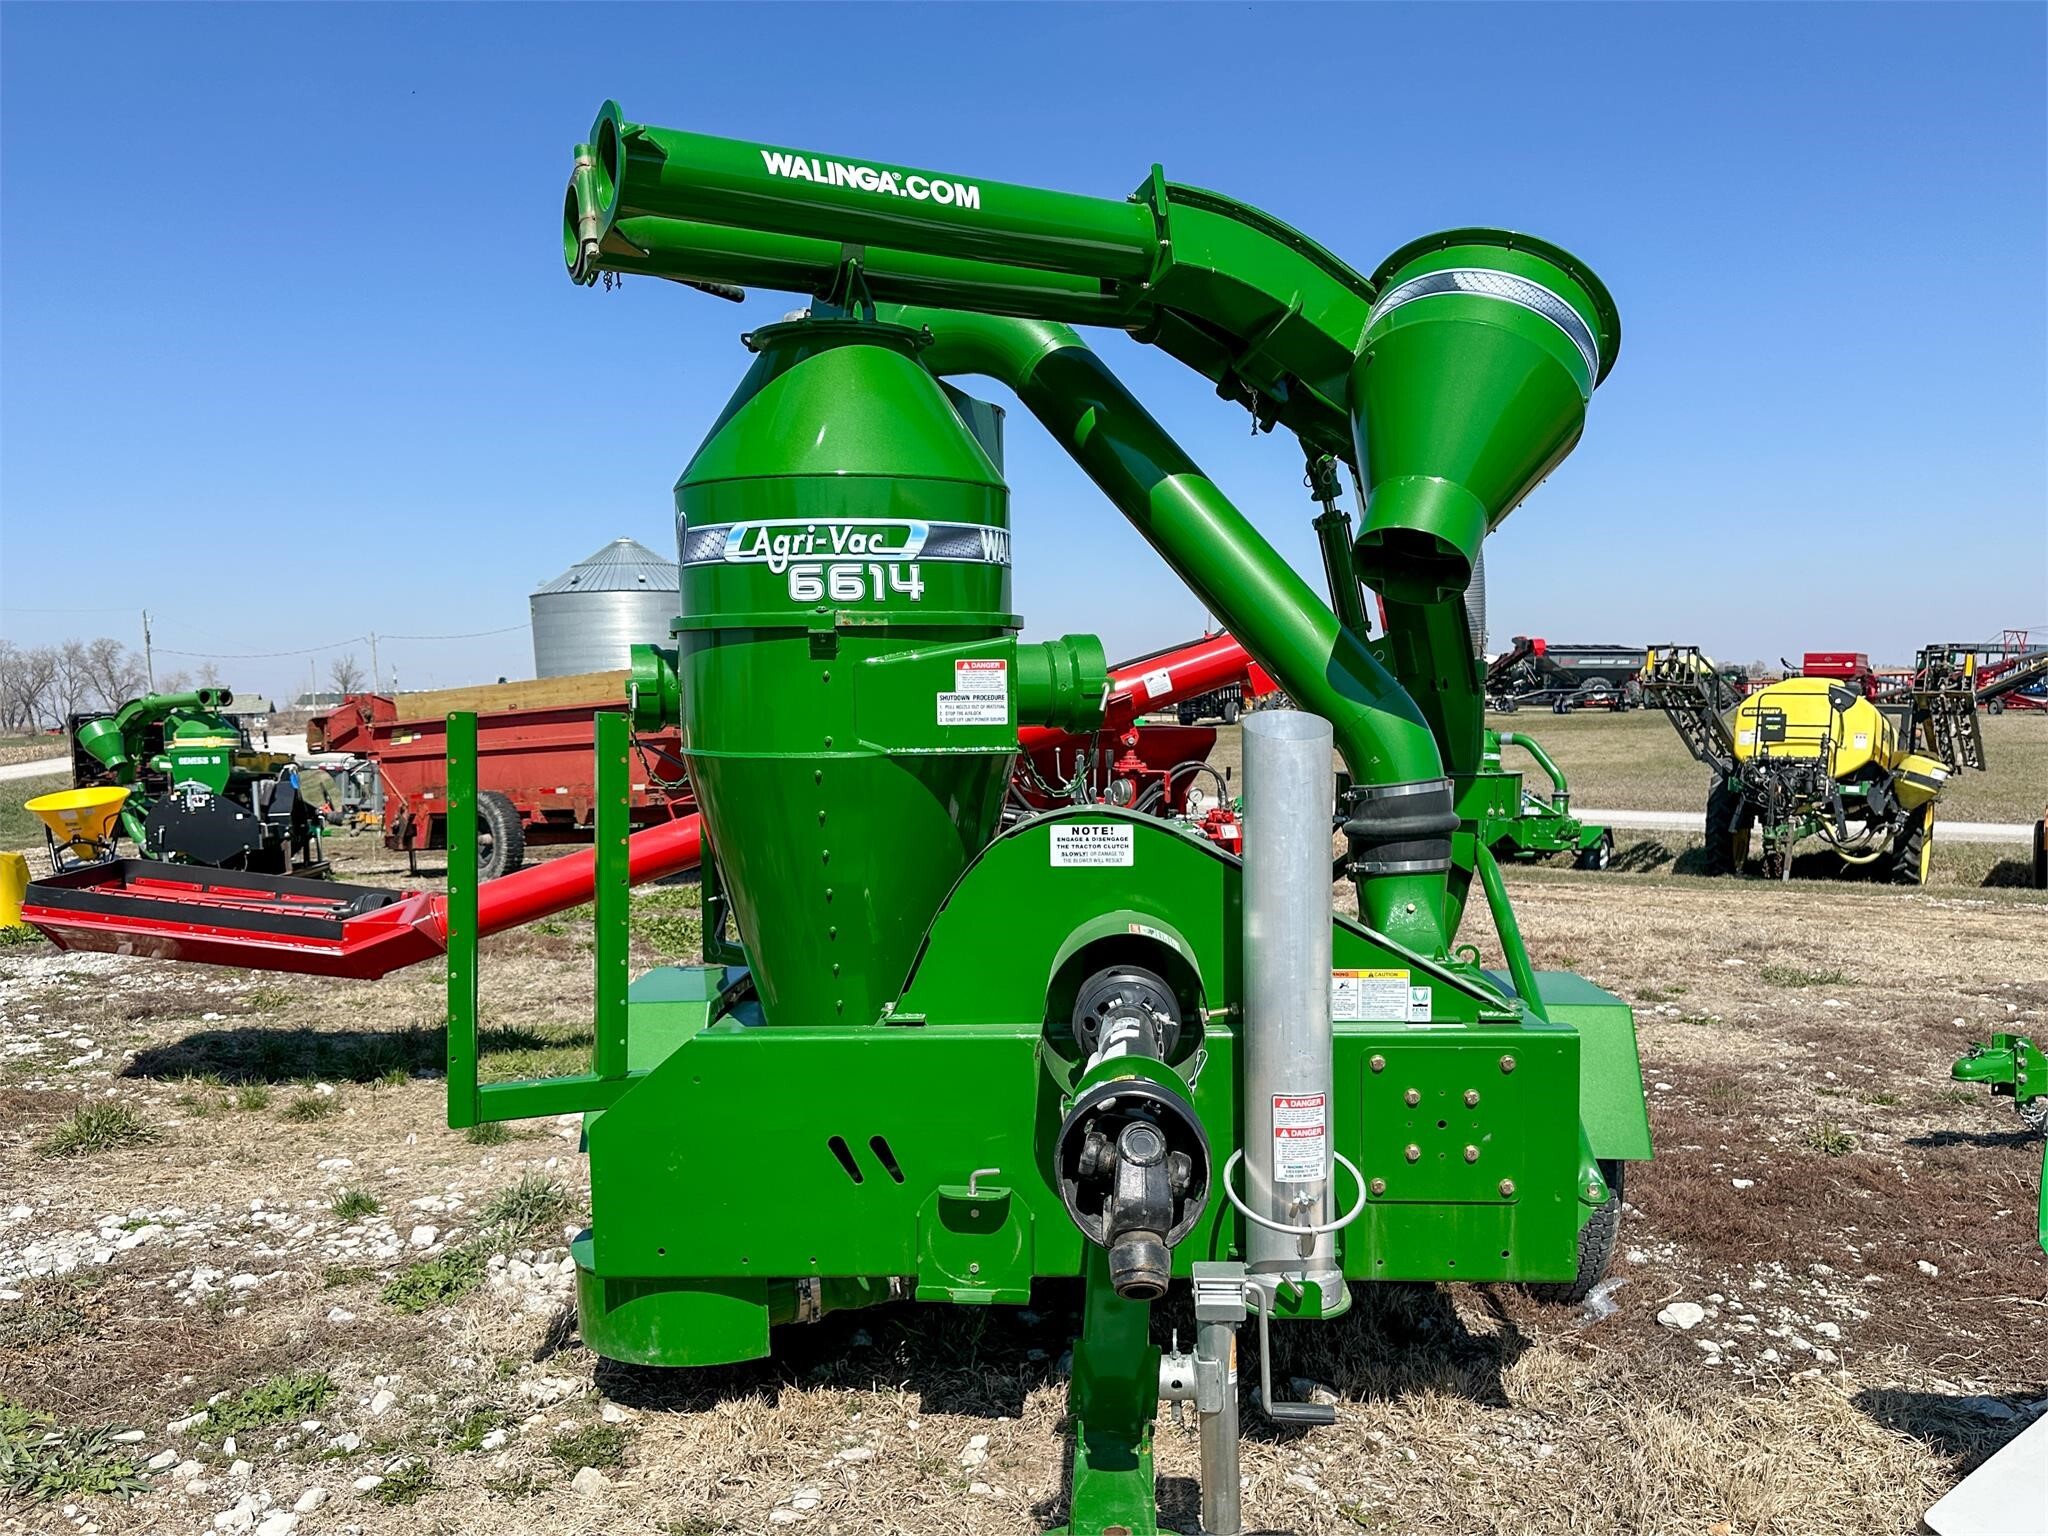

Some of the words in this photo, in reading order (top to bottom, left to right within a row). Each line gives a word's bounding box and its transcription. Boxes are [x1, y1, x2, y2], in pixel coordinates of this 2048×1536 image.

[752, 524, 884, 573] Agri-Vac
[788, 563, 925, 601] 6614
[971, 661, 1001, 669] DANGER
[1071, 826, 1114, 836] NOTE!
[1290, 1098, 1322, 1107] DANGER
[1291, 1128, 1322, 1137] DANGER
